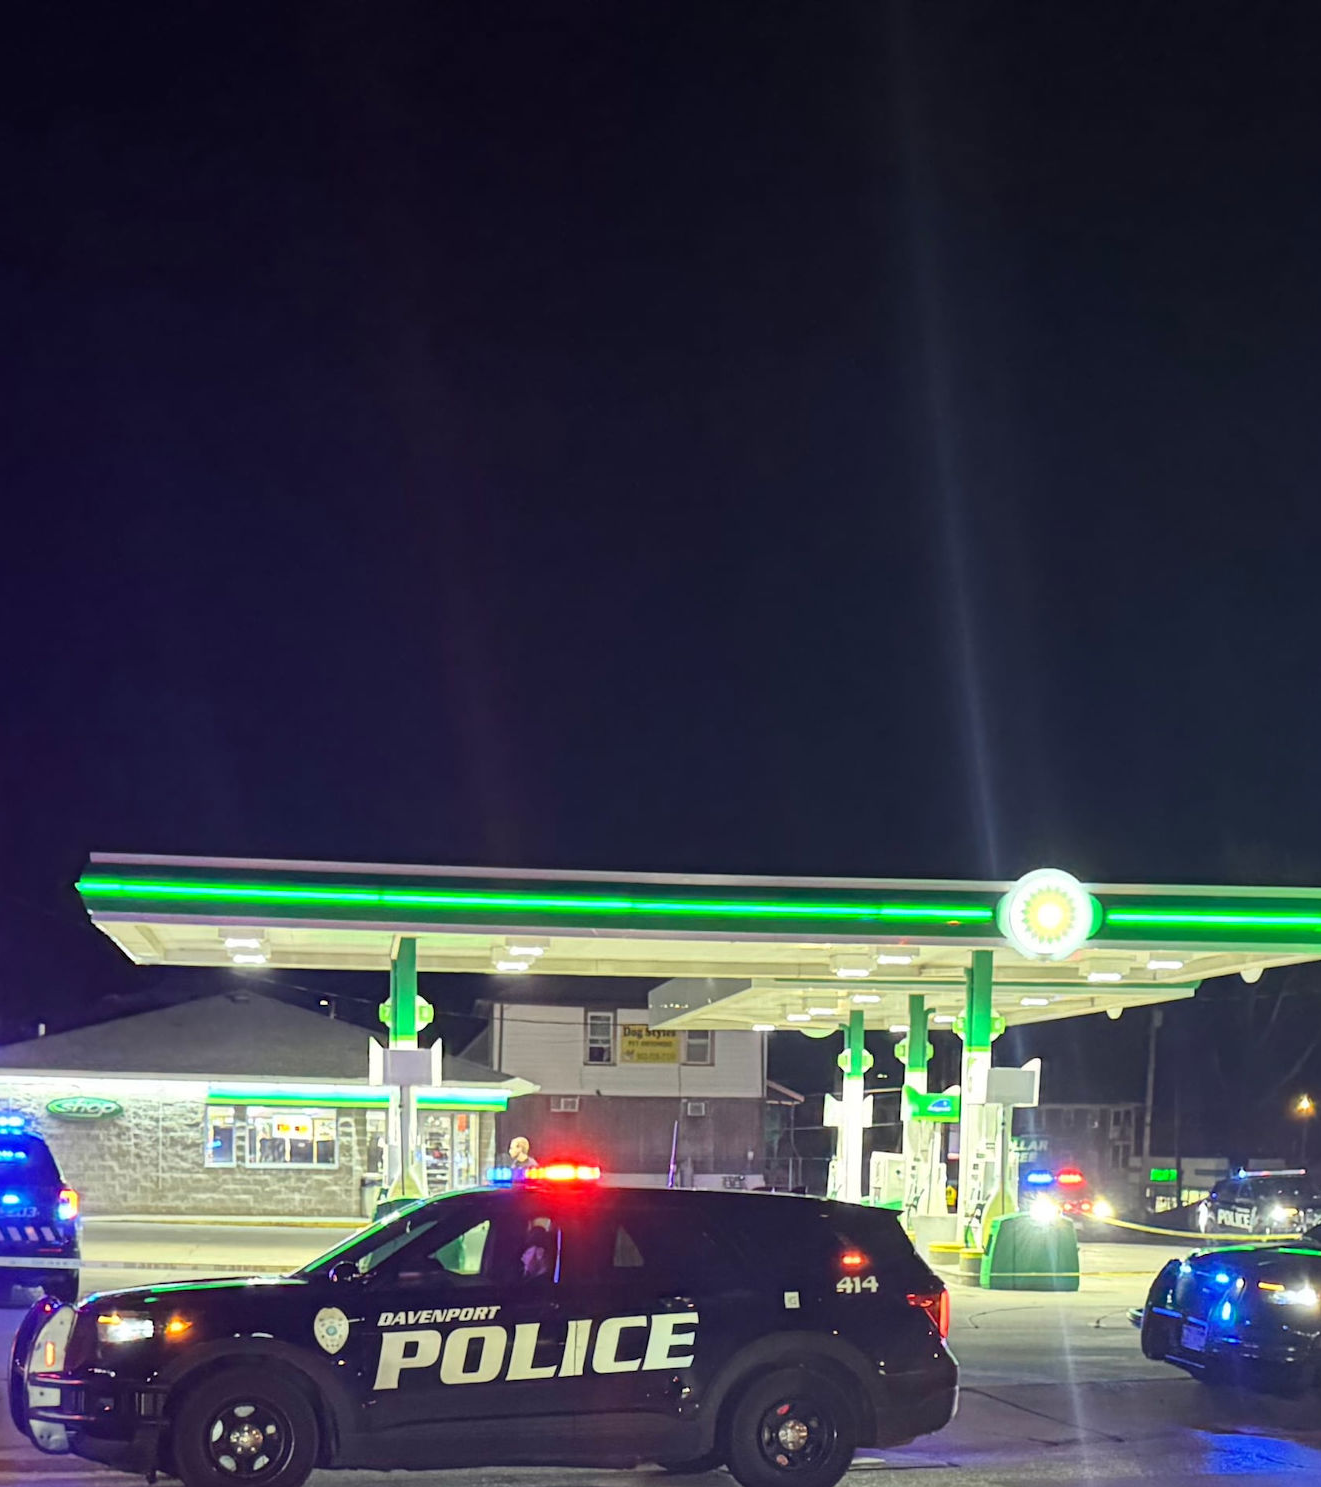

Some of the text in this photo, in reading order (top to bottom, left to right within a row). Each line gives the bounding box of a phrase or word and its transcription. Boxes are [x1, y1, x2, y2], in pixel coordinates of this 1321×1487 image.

[56, 1099, 118, 1118] shop
[1218, 1208, 1254, 1232] POLICE
[836, 1275, 879, 1294] 414
[377, 1305, 501, 1327] DAVENPORT
[373, 1312, 699, 1390] POLICE
